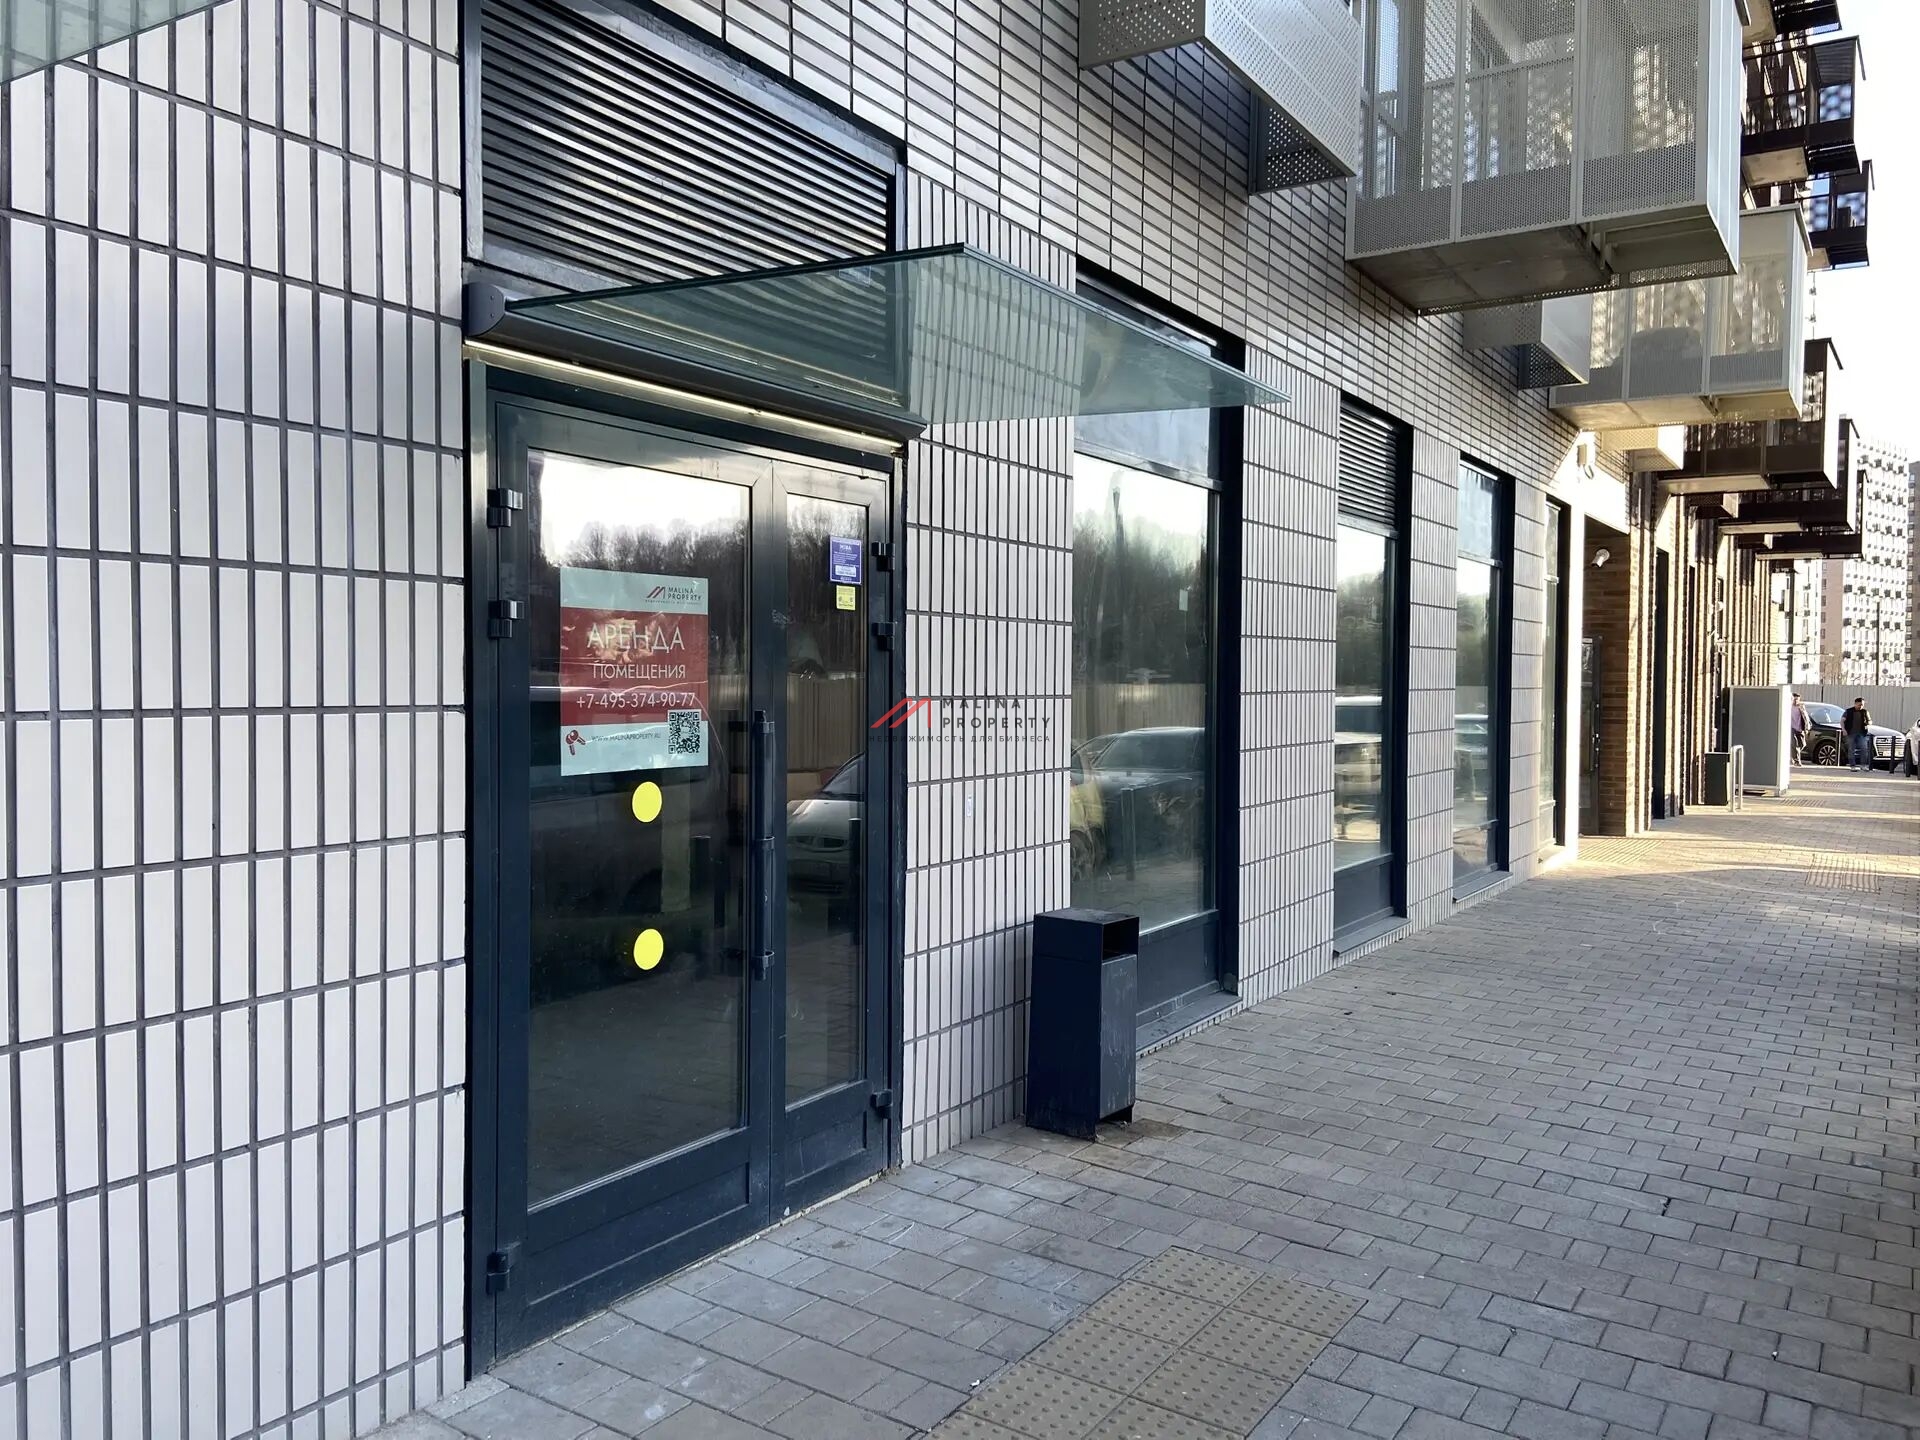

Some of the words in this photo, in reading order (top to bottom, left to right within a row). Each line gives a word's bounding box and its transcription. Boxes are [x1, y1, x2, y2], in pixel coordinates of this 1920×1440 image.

[667, 593, 702, 601] PROPERTY
[586, 622, 685, 653] АРЕНДА
[593, 664, 686, 680] ПОМЕЩЕНИЯ
[576, 692, 695, 709] +7-495-374-90-77
